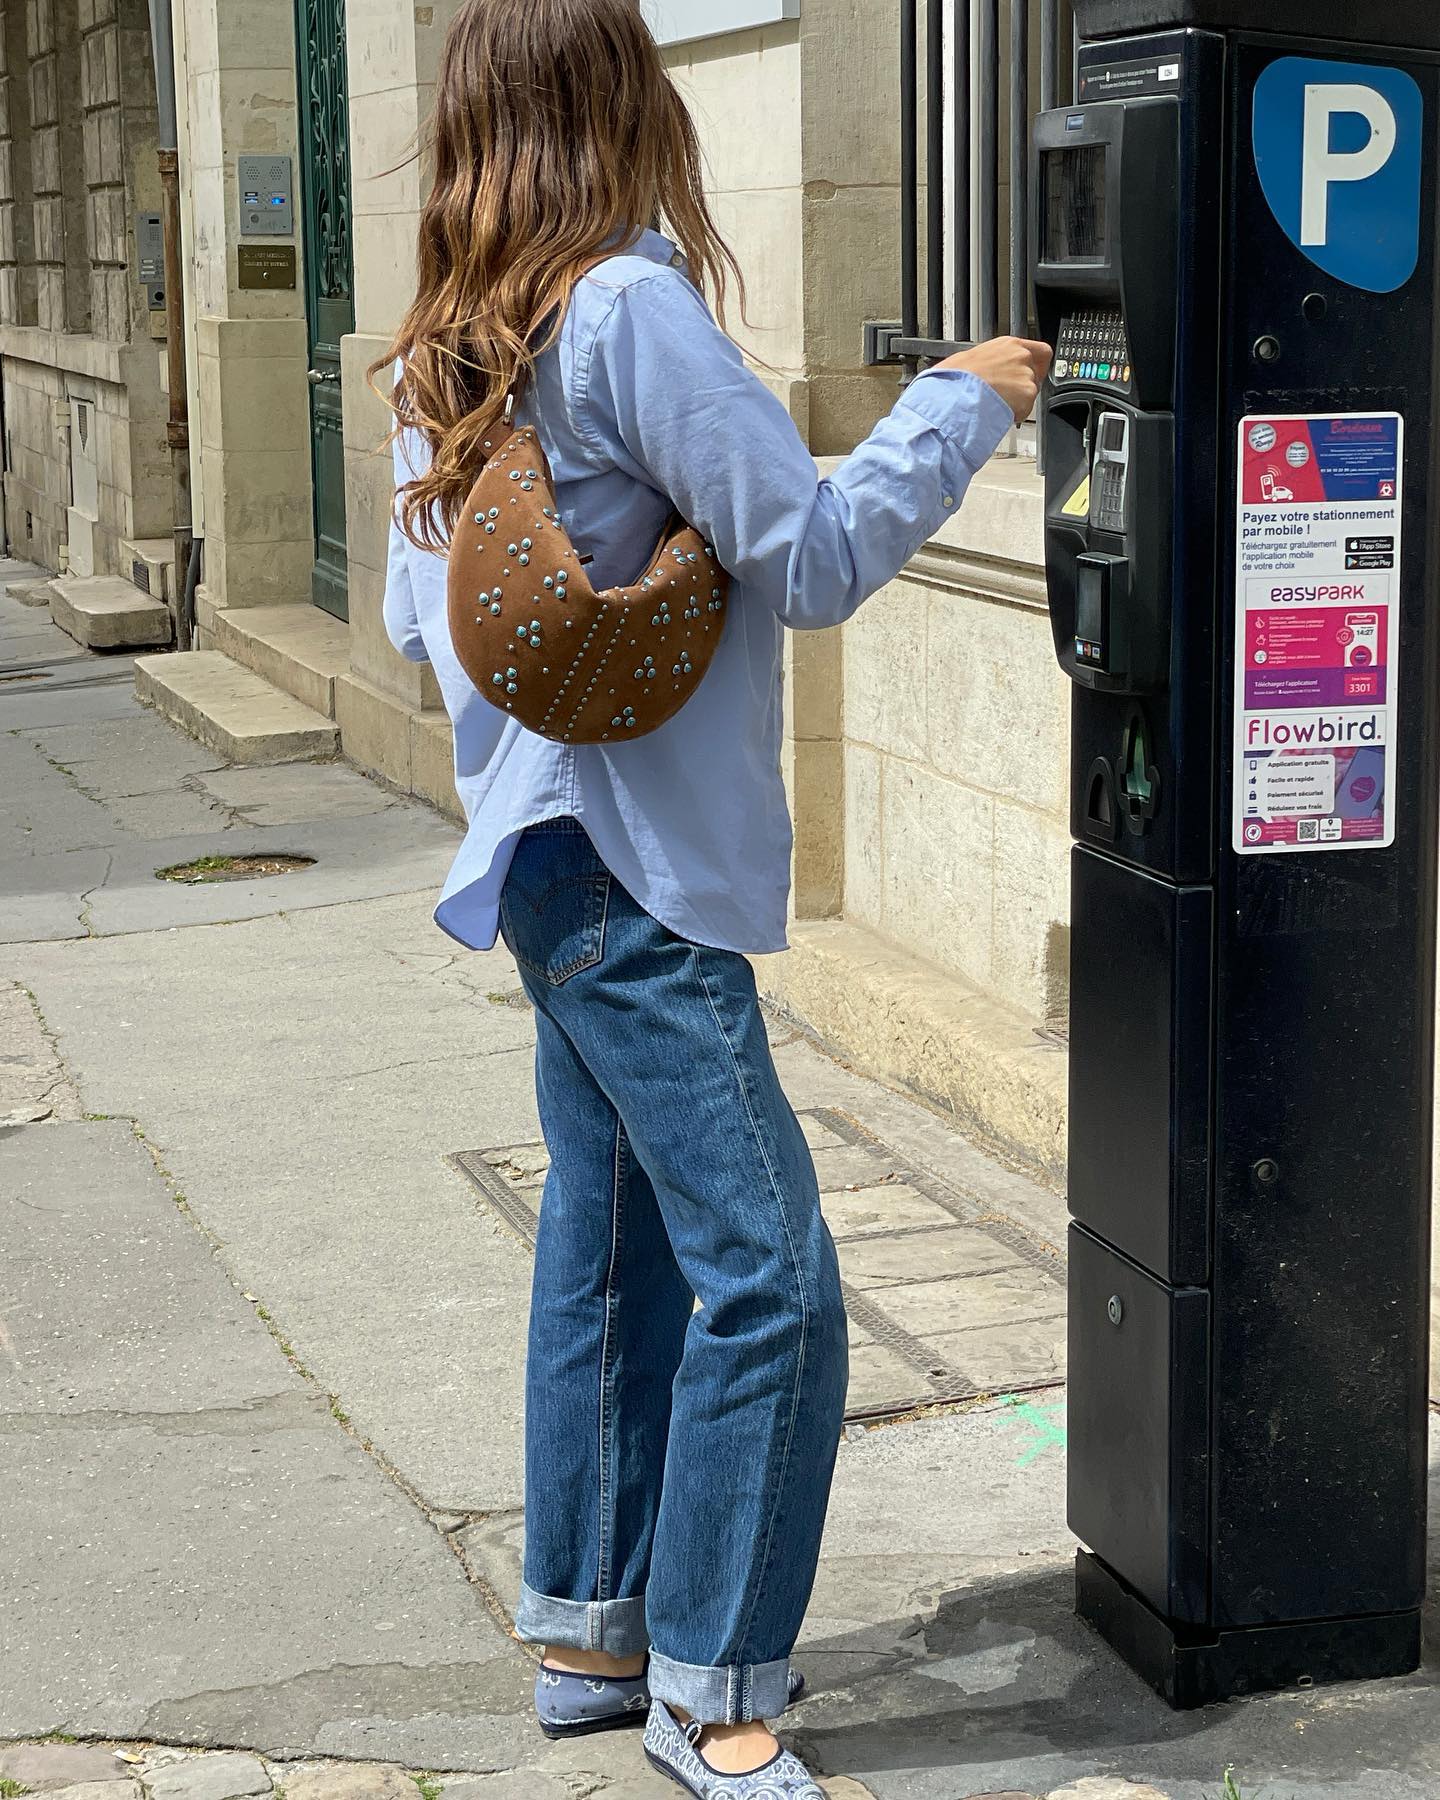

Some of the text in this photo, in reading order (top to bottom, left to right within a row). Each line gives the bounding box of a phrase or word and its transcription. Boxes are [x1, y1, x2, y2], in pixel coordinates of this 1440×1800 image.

[1301, 84, 1396, 245] P
[1243, 509, 1394, 525] Payez votre stationnement
[1243, 528, 1261, 538] par
[1264, 524, 1303, 536] mobile
[1241, 540, 1337, 551] Téléchargez gratuitement
[1289, 551, 1314, 559] mobile
[1349, 683, 1371, 693] 3301
[1248, 715, 1381, 745] flowbird.
